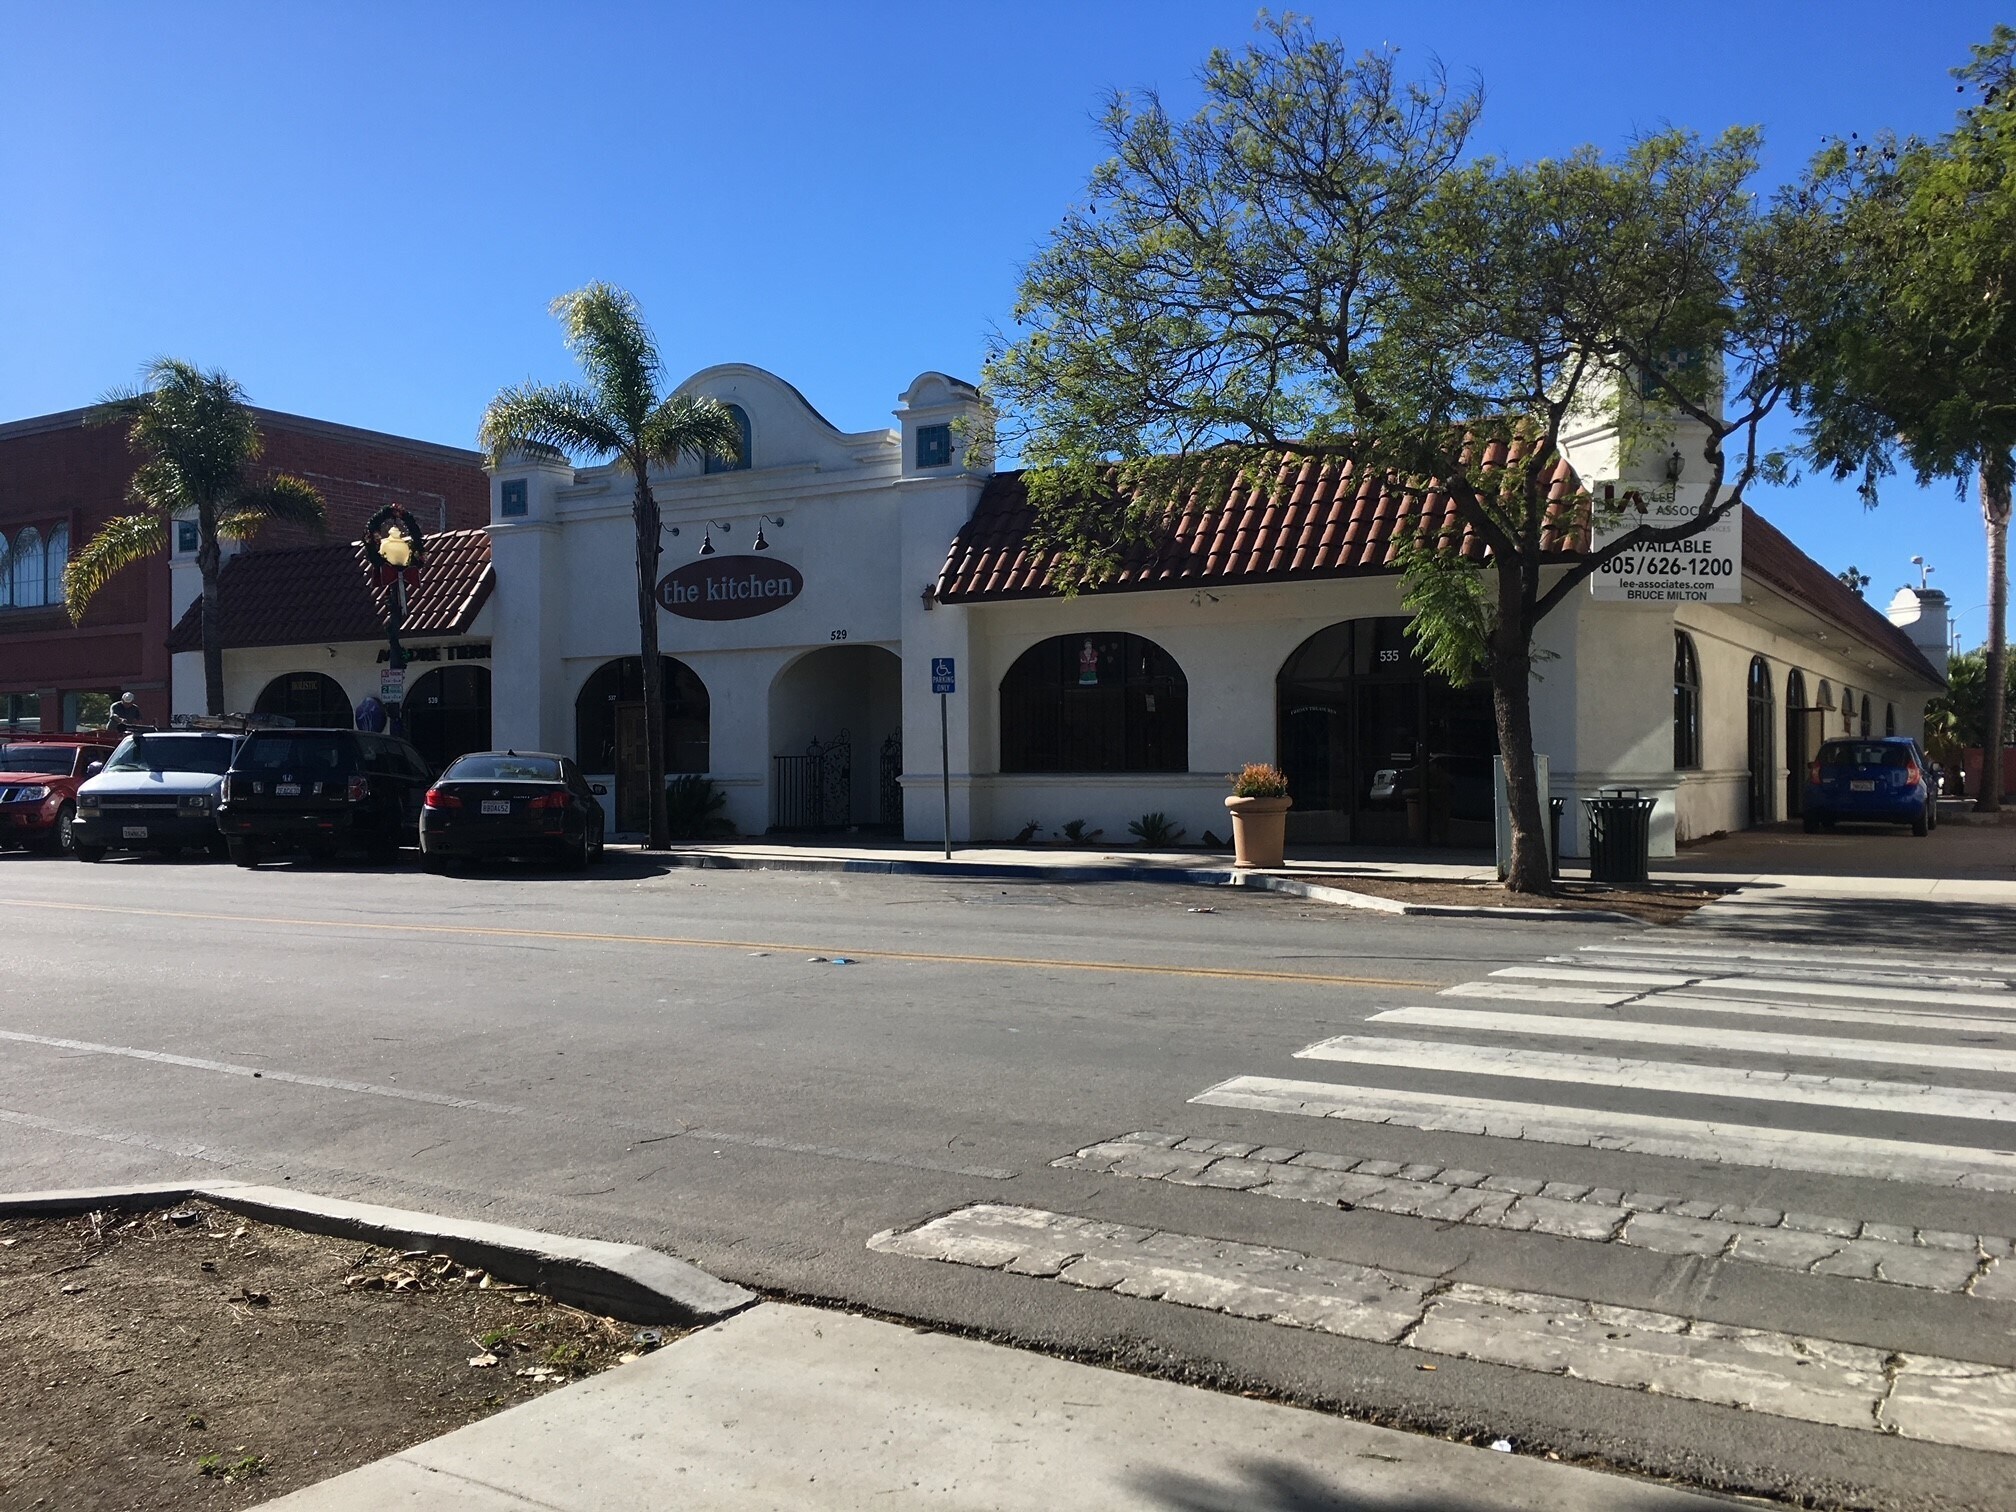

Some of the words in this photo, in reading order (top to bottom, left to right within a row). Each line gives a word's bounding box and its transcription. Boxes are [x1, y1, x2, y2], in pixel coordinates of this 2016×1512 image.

[1601, 556, 1733, 576] 805/626-1200
[663, 580, 698, 604] the
[706, 574, 793, 601] kitchen
[1619, 578, 1715, 590] lee-associates.com
[1627, 590, 1664, 600] BRUCE
[1666, 591, 1707, 600] MILTON
[830, 629, 847, 640] 529
[1380, 650, 1399, 662] 535
